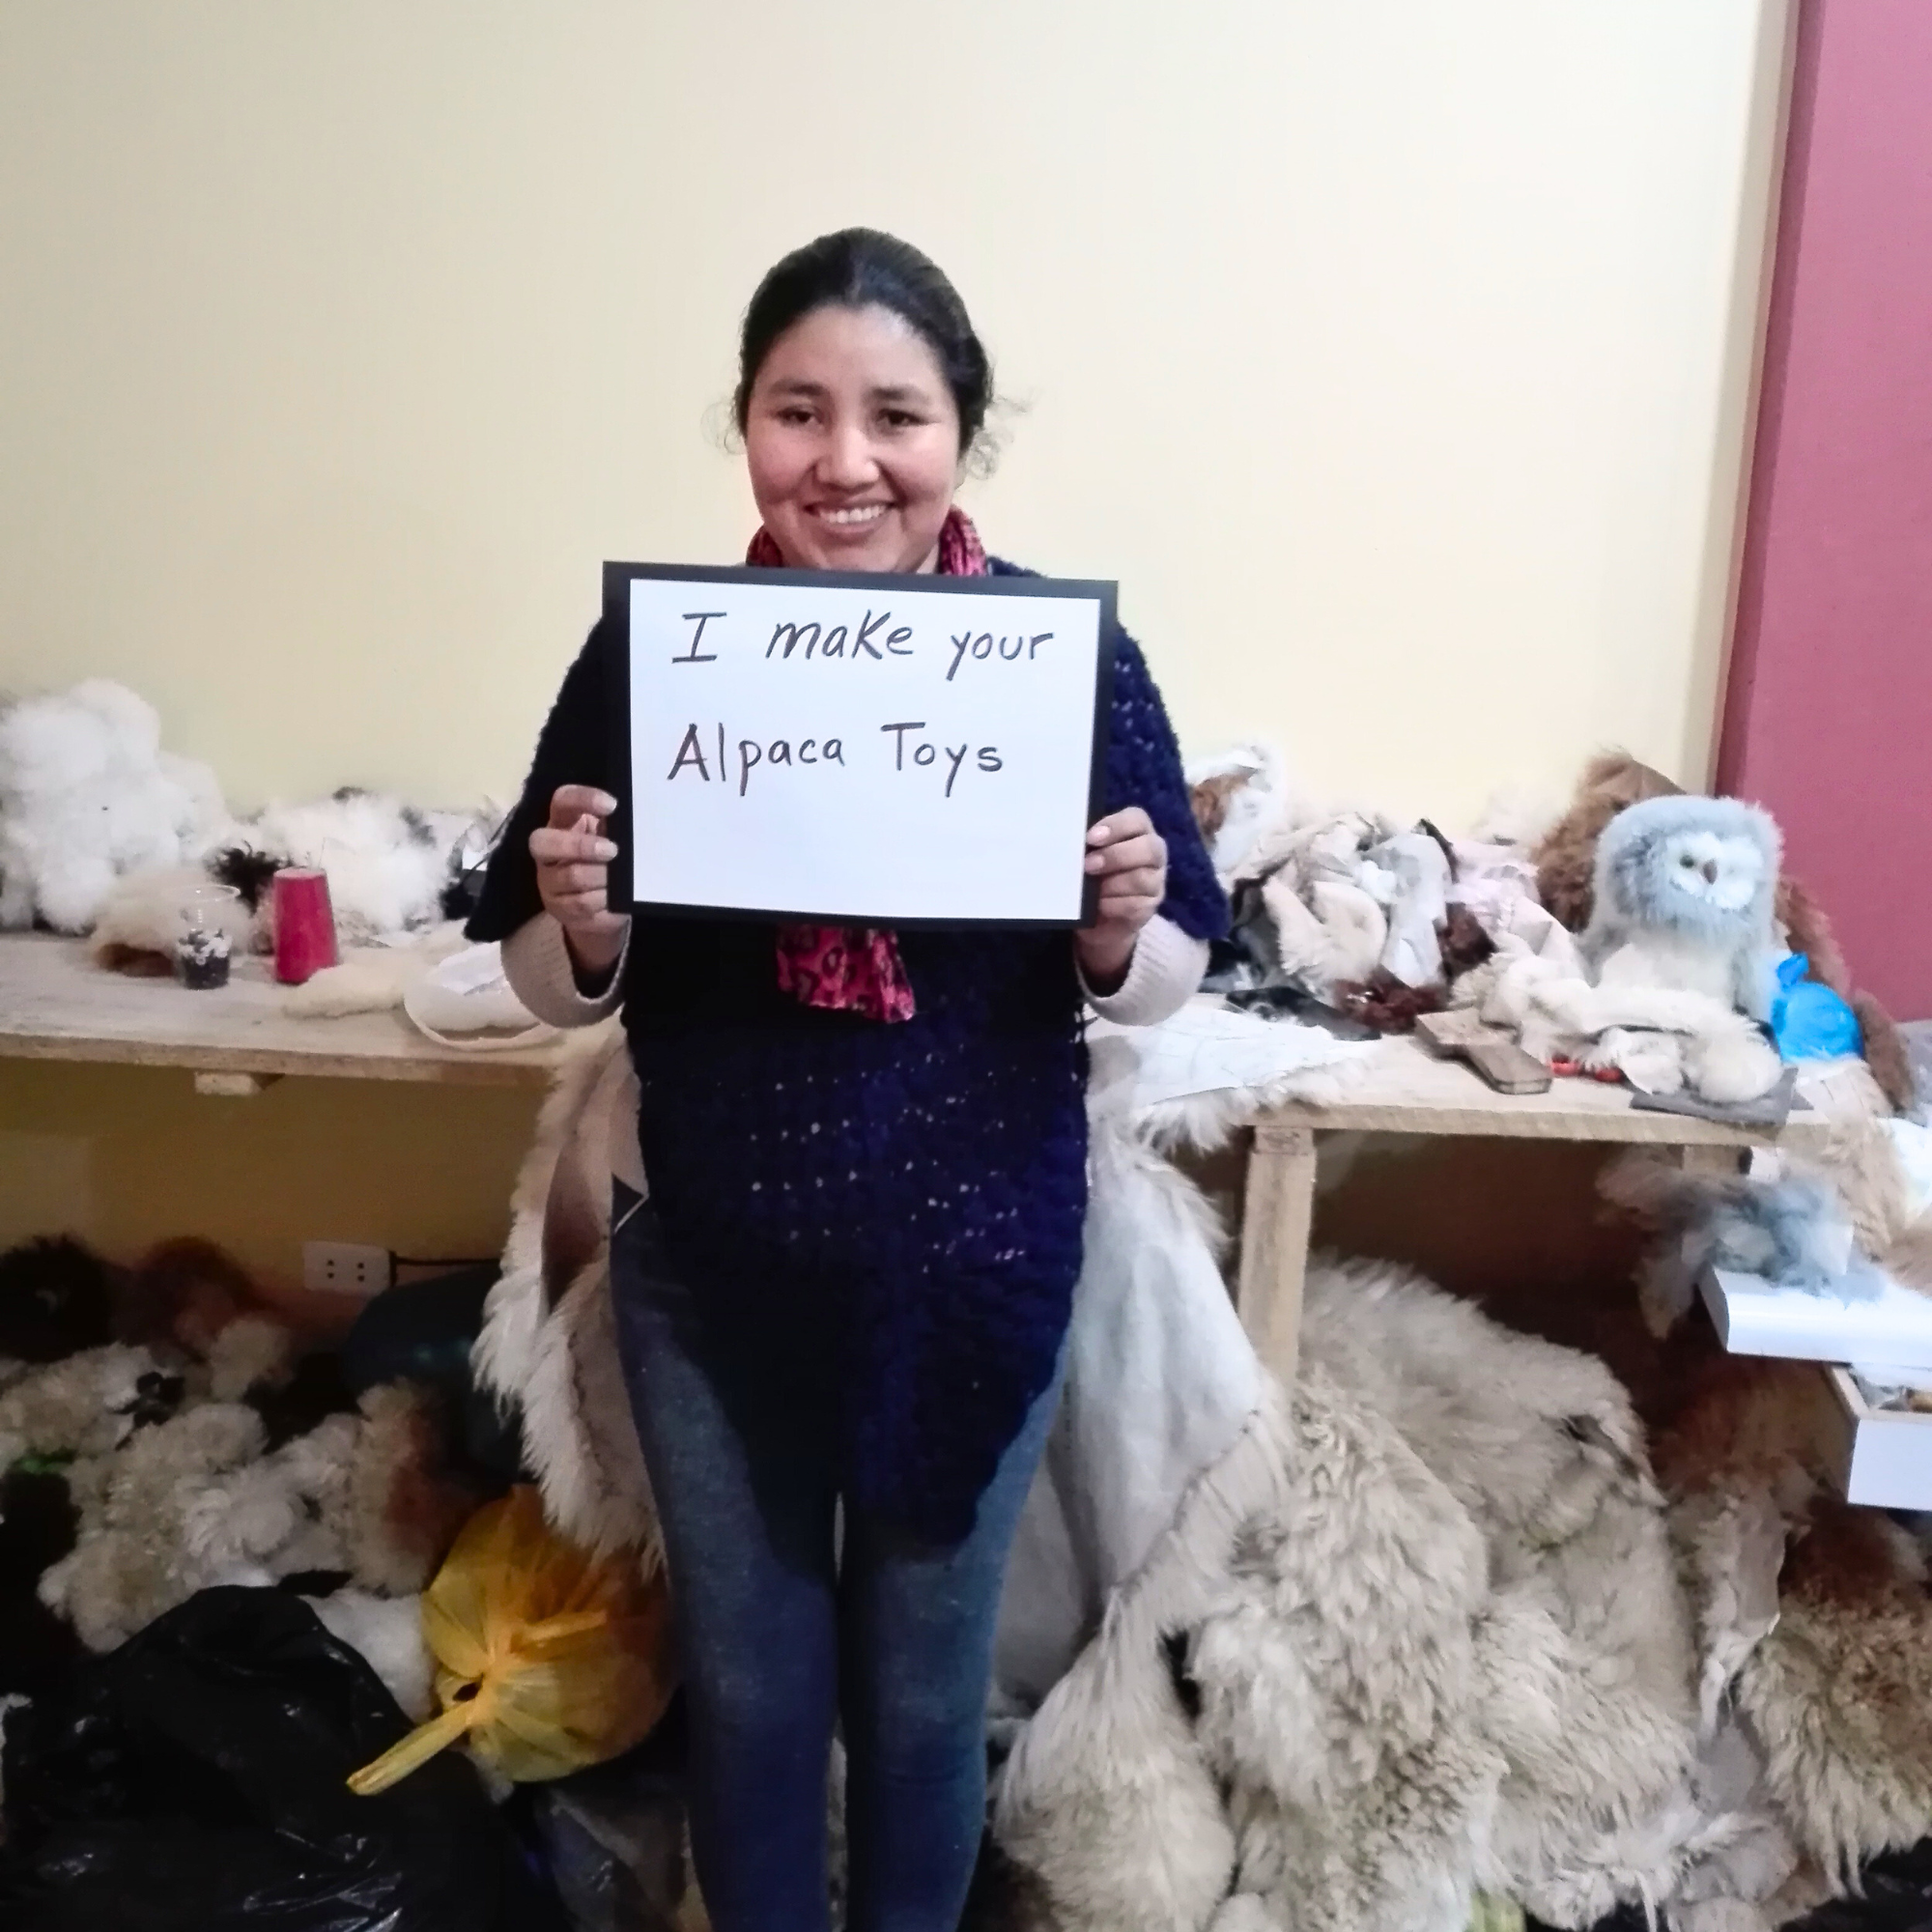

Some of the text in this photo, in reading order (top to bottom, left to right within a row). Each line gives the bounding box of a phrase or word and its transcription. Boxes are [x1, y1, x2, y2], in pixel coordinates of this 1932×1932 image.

[671, 611, 727, 664] I
[946, 632, 1054, 681] your
[667, 722, 1004, 798] Alpaca Toys
